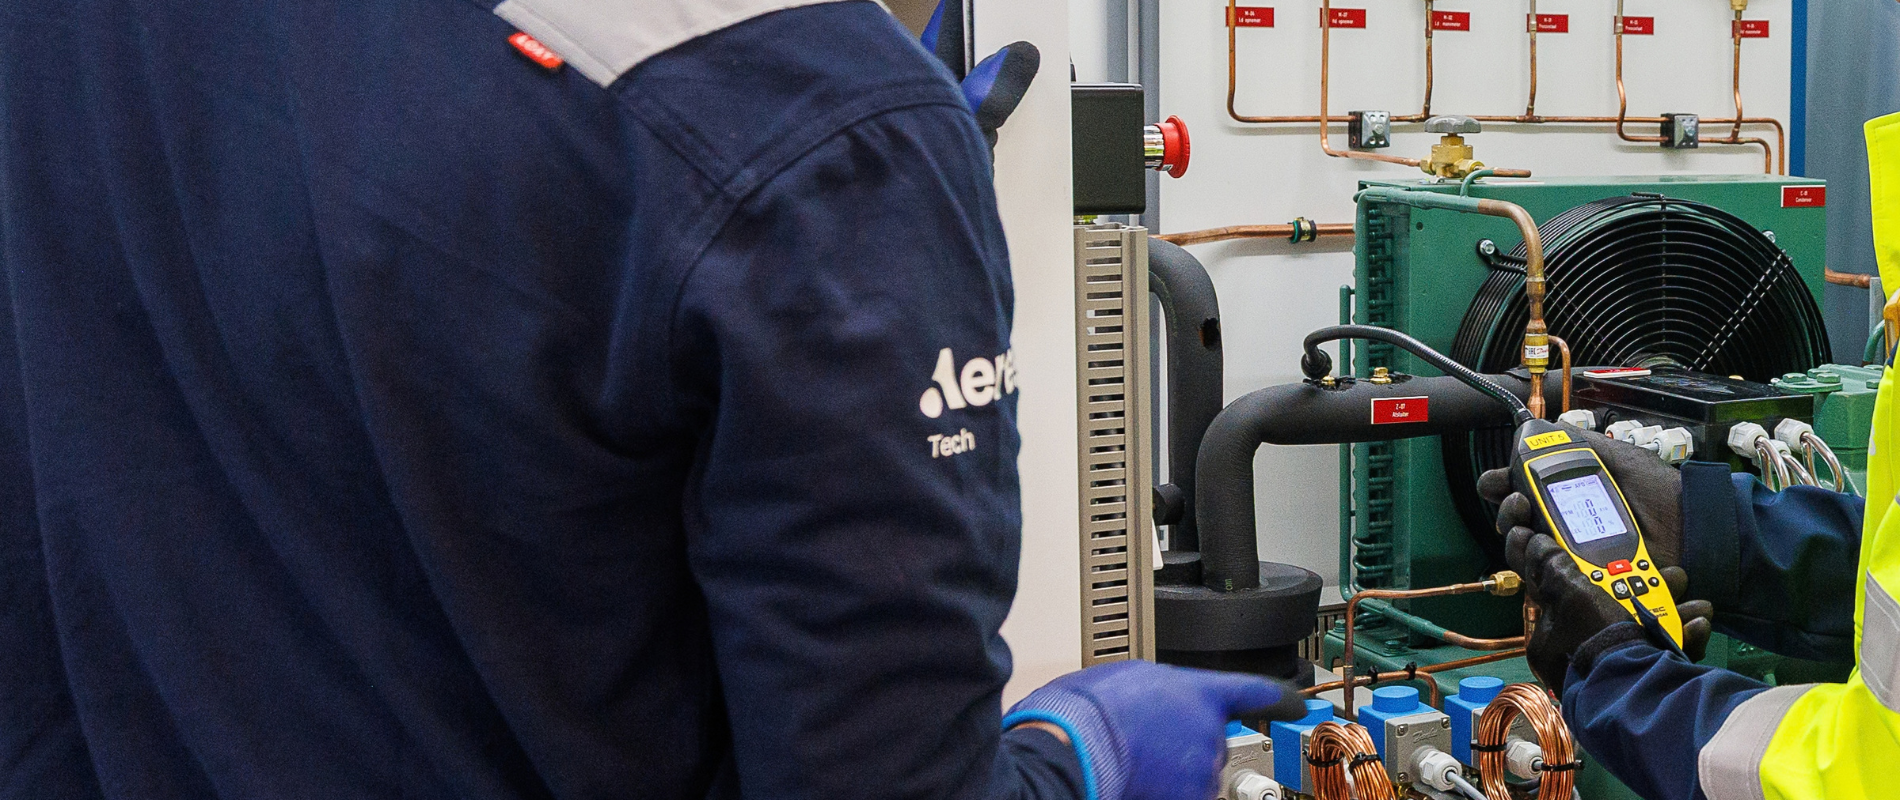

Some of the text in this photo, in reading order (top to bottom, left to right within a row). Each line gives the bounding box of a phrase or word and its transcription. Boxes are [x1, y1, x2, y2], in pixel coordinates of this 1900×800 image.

[927, 427, 976, 458] Tech
[1530, 433, 1565, 446] UNIT 5
